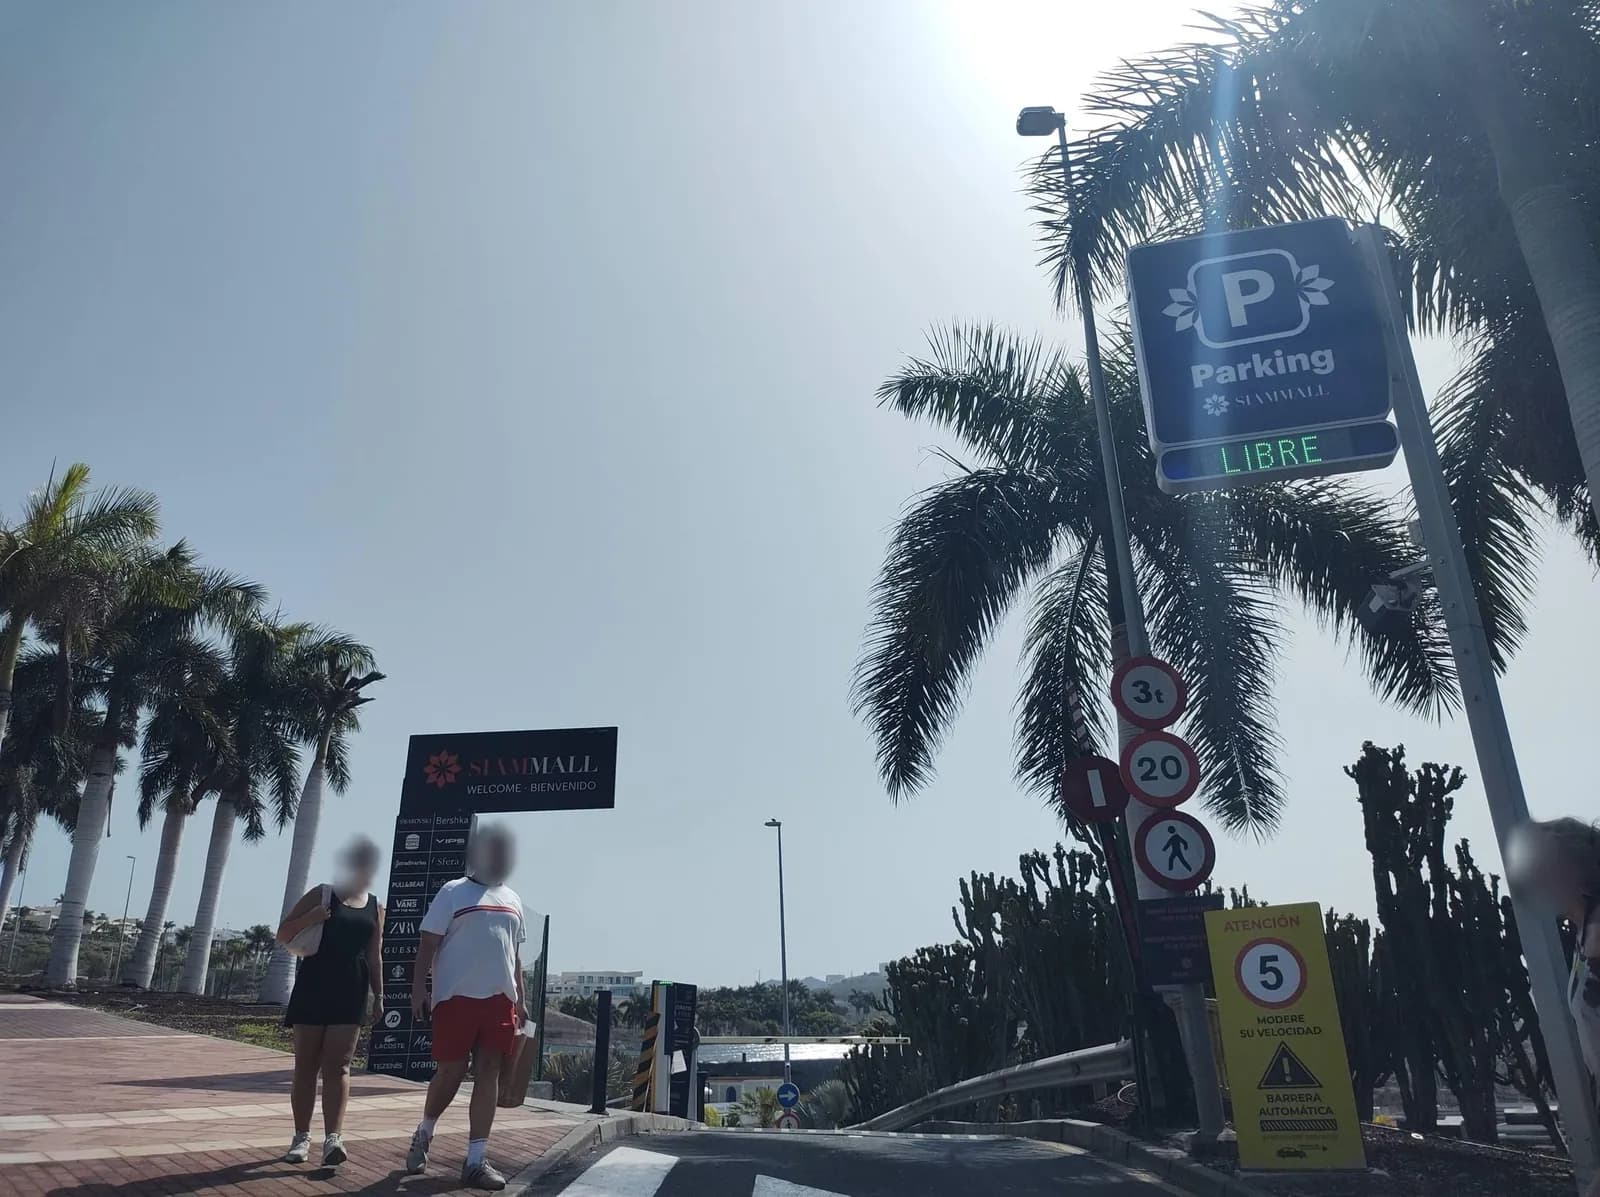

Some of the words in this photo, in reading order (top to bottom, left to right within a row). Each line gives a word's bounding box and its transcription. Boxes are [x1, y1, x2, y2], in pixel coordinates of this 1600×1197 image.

[1221, 269, 1275, 328] P
[1191, 349, 1336, 388] Parking
[1220, 435, 1322, 473] LIBRE
[1131, 680, 1165, 704] 3t
[1137, 755, 1182, 782] 20
[467, 783, 521, 795] WELCOME
[530, 781, 596, 793] BIENVENIDO
[436, 816, 469, 825] Bershka
[392, 880, 425, 888] PULL&BEAR
[395, 899, 418, 908] VANS
[1223, 915, 1301, 932] ATENCIÓN
[384, 946, 418, 954] GUESS
[1260, 955, 1284, 990] 5
[382, 992, 413, 1000] ANDORA
[1256, 1014, 1305, 1025] MODERE
[1240, 1030, 1254, 1039] SU
[1257, 1026, 1322, 1038] VELOCIDAD
[374, 1042, 406, 1050] LACOSTE
[410, 1060, 438, 1070] orang
[1266, 1093, 1322, 1104] BARRERA
[1259, 1104, 1333, 1117] AUTOMÁTICA
